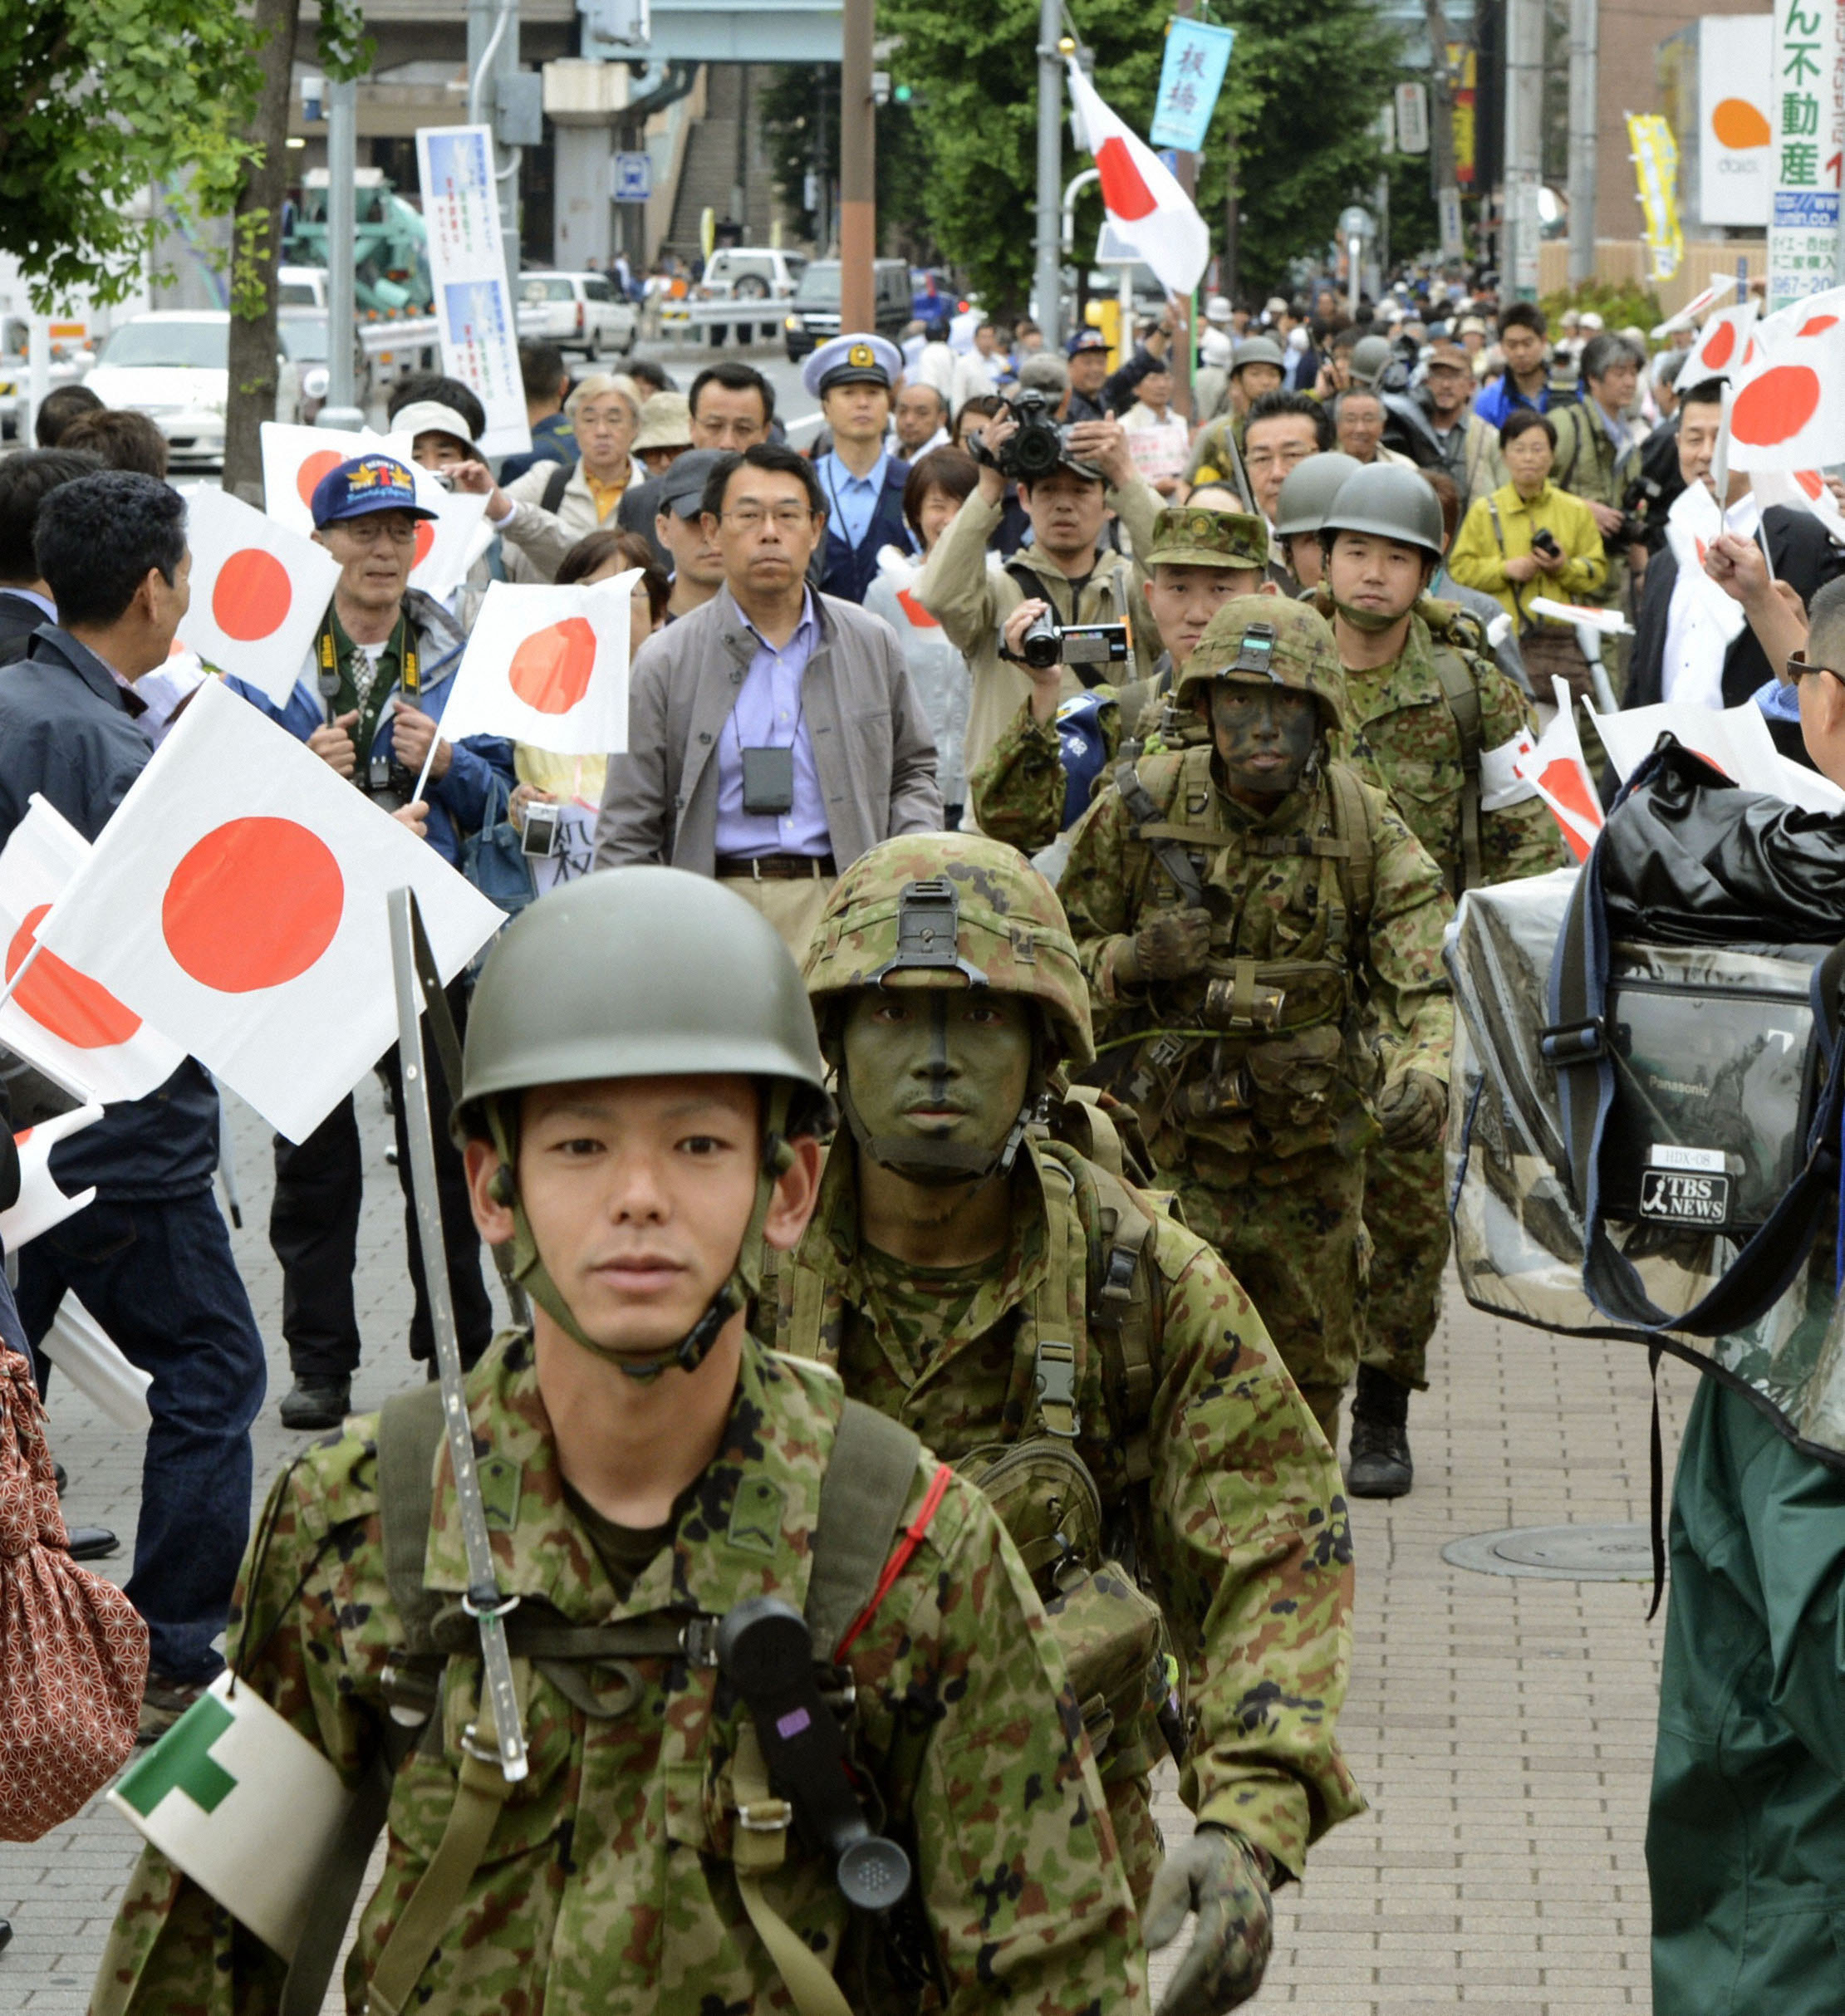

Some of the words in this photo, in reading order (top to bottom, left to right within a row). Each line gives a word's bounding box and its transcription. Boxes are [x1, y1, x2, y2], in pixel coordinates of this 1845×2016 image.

[1167, 42, 1207, 115] 板橋
[1649, 1075, 1710, 1097] Panasonic
[1666, 1176, 1712, 1199] TBS
[1671, 1198, 1723, 1219] NEWS
